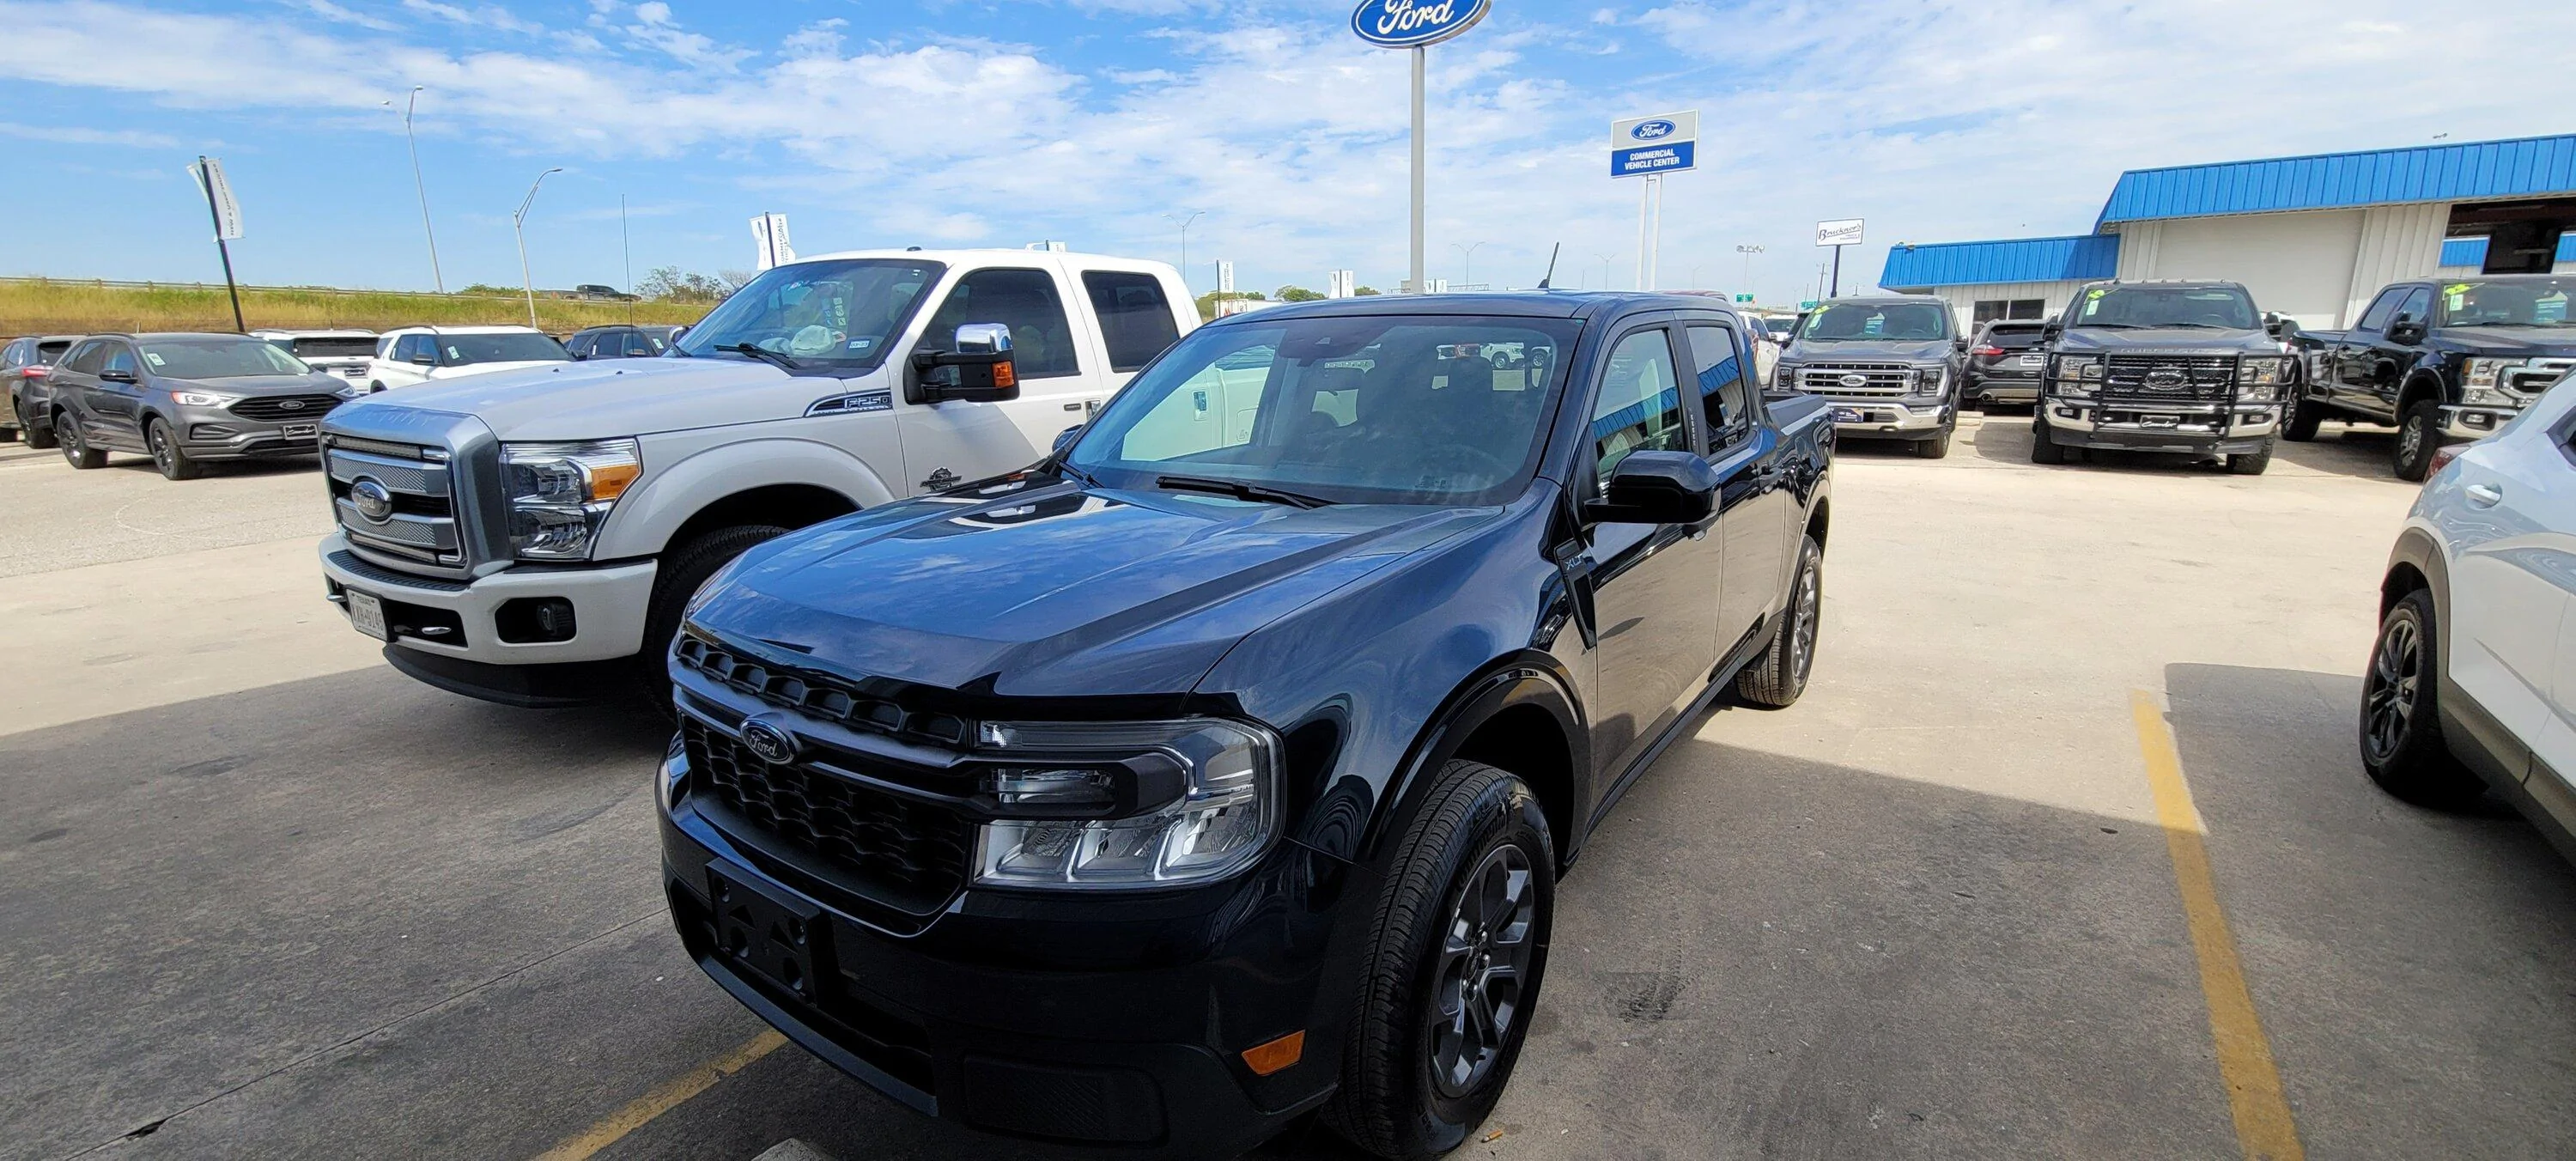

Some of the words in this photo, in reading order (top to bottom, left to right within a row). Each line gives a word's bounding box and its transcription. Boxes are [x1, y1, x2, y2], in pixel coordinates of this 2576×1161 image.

[1376, 0, 1455, 34] Ford
[1639, 123, 1668, 137] Ford
[1630, 149, 1675, 161] COMMERCIAL
[1625, 161, 1652, 170] VEHICLE
[1653, 156, 1680, 167] CENTER
[1565, 553, 1583, 570] XLT
[750, 729, 778, 757] Ford
